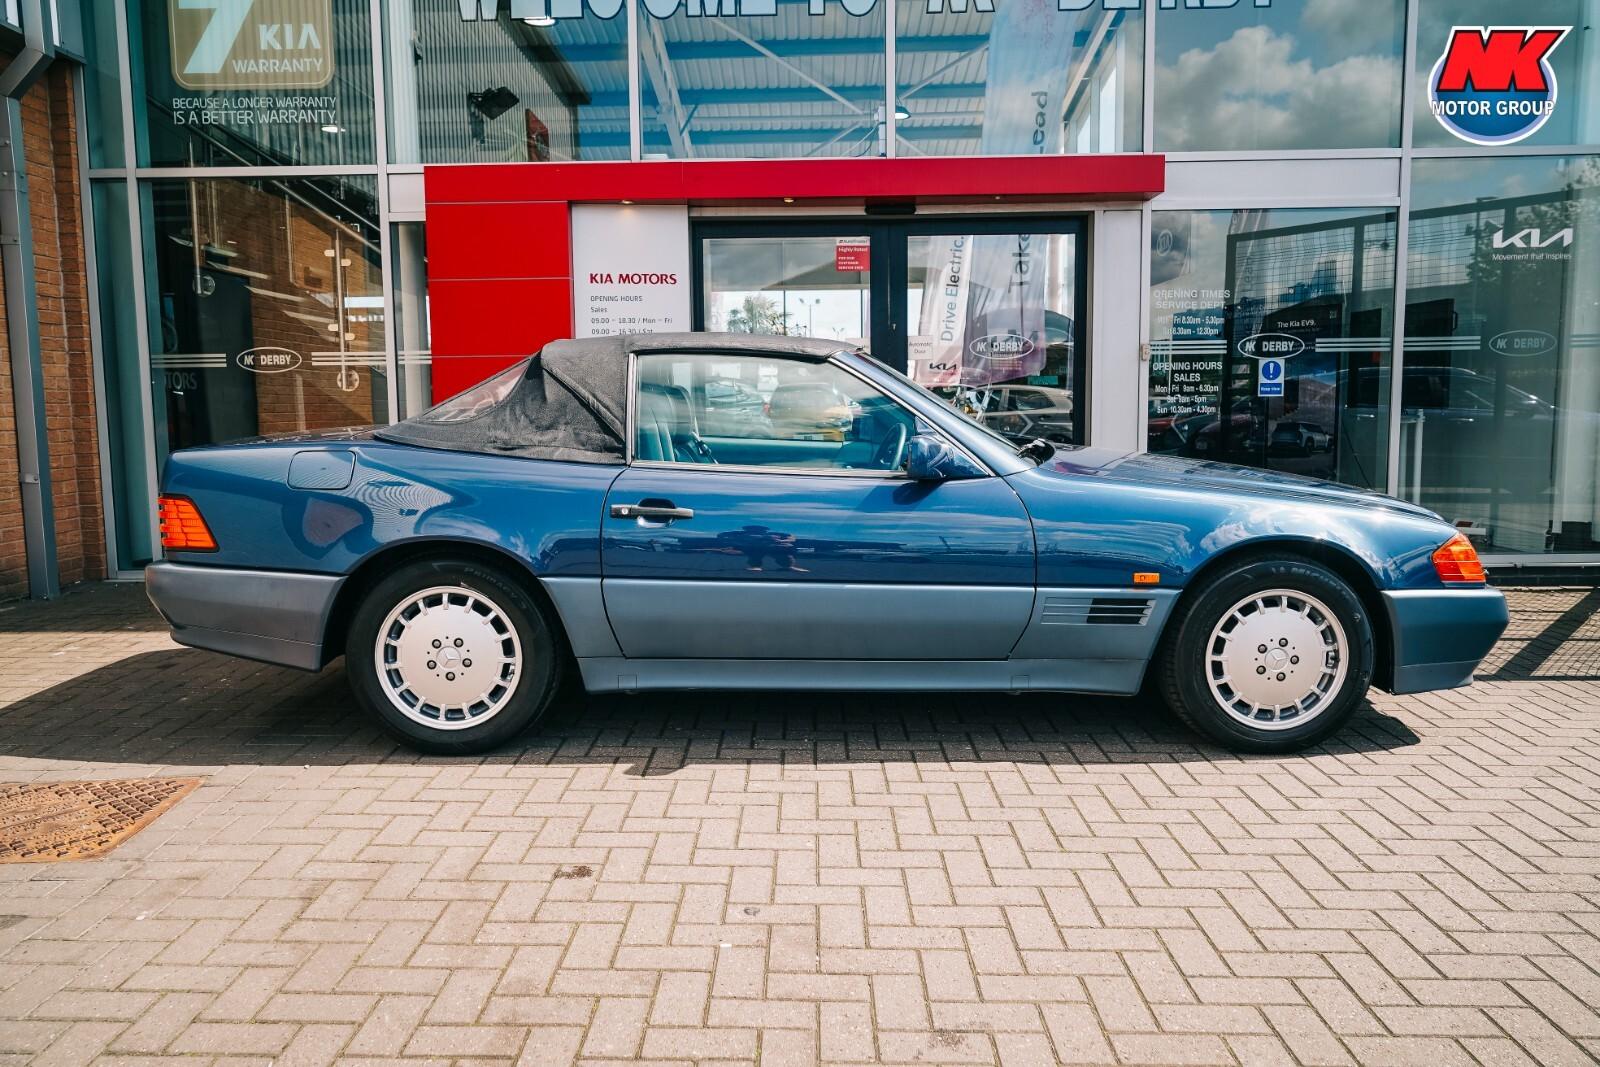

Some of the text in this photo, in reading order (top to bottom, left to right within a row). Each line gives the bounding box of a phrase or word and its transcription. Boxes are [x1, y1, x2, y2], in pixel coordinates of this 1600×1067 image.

[259, 23, 321, 50] KIA
[232, 58, 323, 74] WARRANTY
[173, 96, 337, 109] BECAUSE A LONGER WARRANTY
[173, 110, 338, 125] IS A BETTER WARRANTY.
[1492, 228, 1574, 249] KIA
[1492, 253, 1529, 261] Movement
[1546, 253, 1572, 262] inspires
[1008, 234, 1031, 294] Take
[589, 273, 677, 285] KIA MOTORS
[940, 236, 965, 342] Drive Electric.
[1153, 289, 1231, 299] OPENING TIMES
[1156, 301, 1198, 309] SERVICE
[1289, 320, 1300, 328] Kia
[993, 342, 1024, 352] DERBY
[1262, 341, 1295, 352] DERBY
[1514, 338, 1547, 349] DERBY
[260, 355, 291, 365] DERBY
[929, 362, 957, 370] KIA
[1152, 361, 1223, 371] OPENING HOURS
[1174, 373, 1201, 382] SALES
[1155, 385, 1168, 393] Mon
